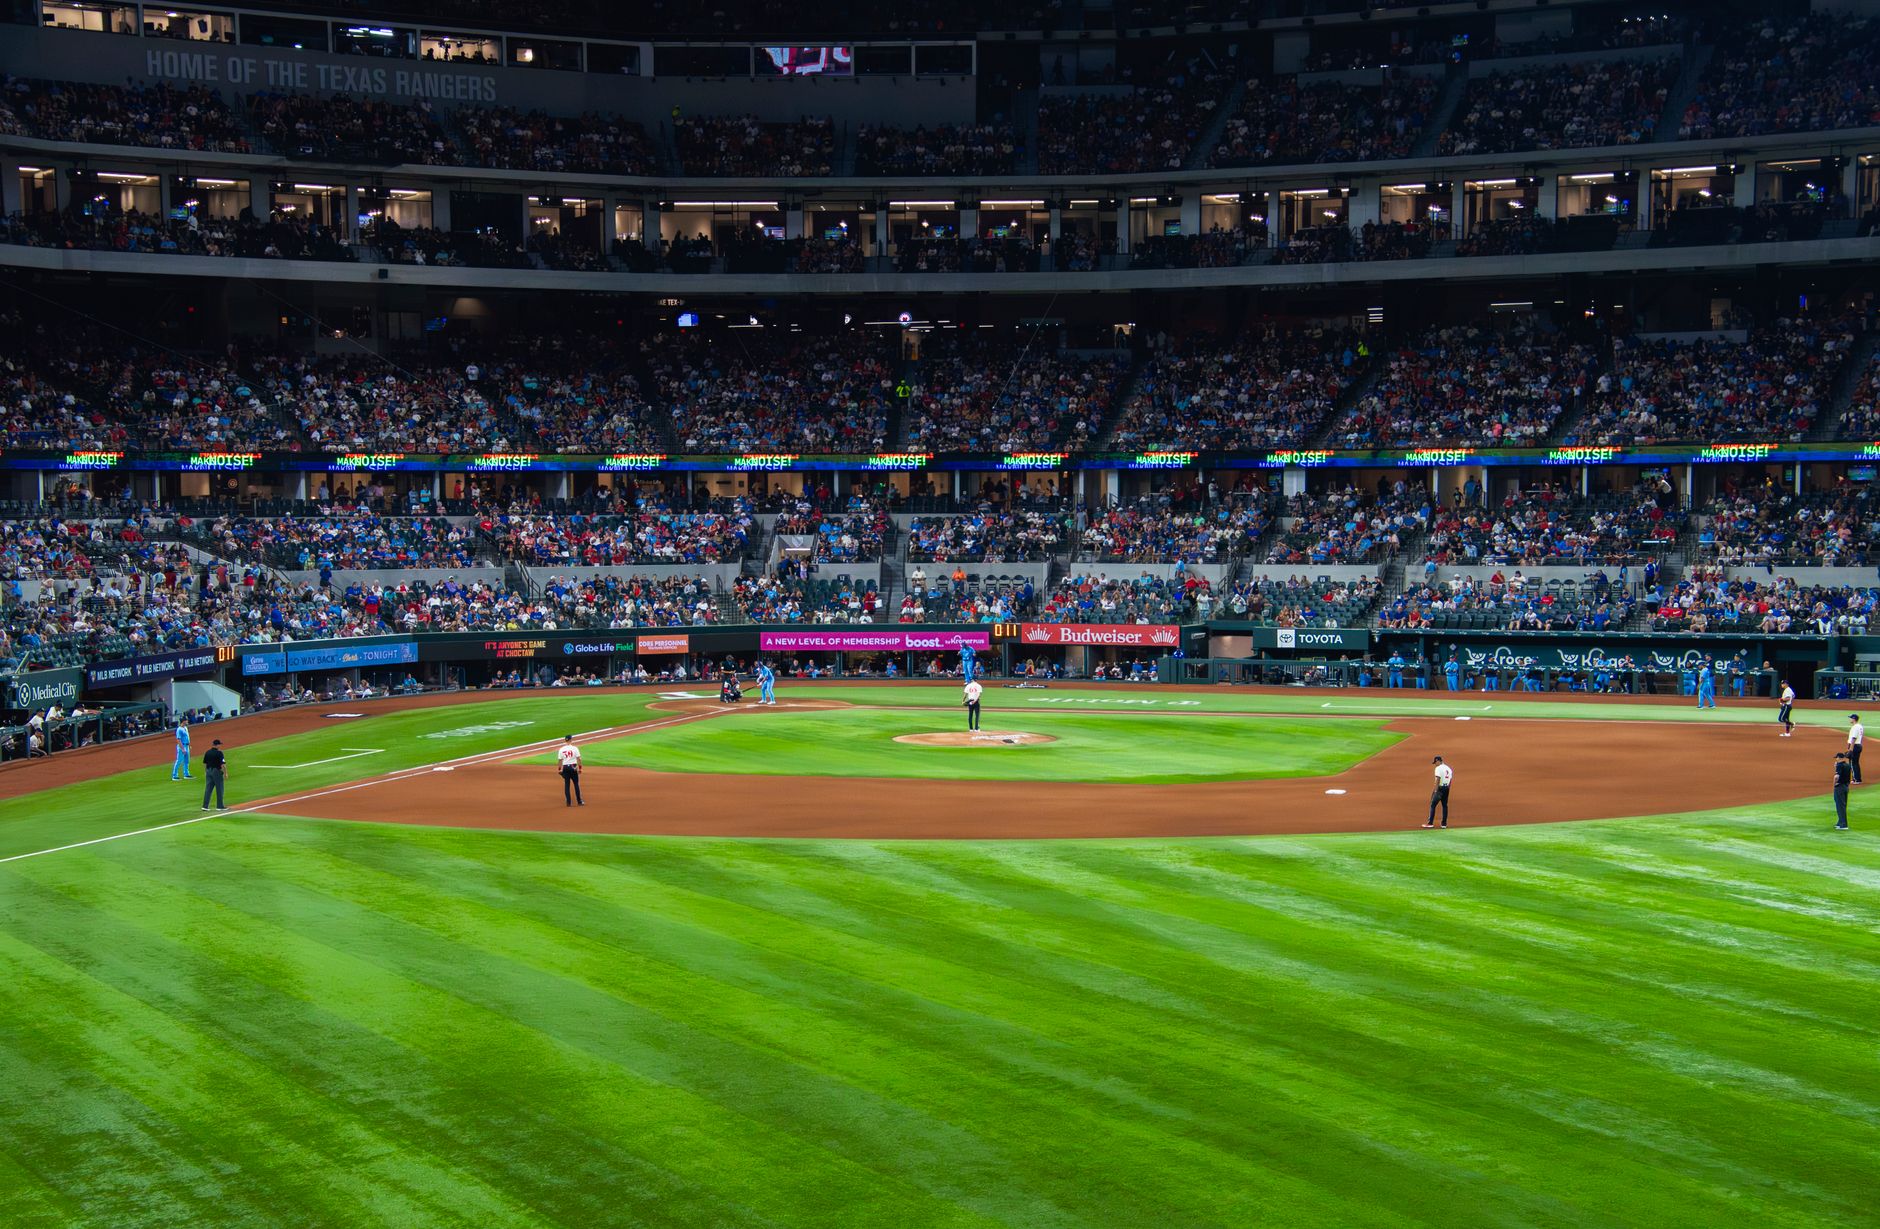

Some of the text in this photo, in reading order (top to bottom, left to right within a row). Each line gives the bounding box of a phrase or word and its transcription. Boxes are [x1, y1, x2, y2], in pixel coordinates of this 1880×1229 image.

[146, 49, 497, 102] HOME OF THE TEXAS RANGERS
[1060, 627, 1142, 643] Budweiser
[1299, 634, 1343, 644] TOYOTA
[485, 640, 546, 650] IT'S ANYONE'S GAME
[575, 643, 634, 653] Globe Life Field
[289, 656, 300, 667] GO
[302, 655, 316, 666] WAY
[364, 649, 398, 661] TONIGHT
[505, 649, 535, 657] CHOCTAW
[142, 661, 175, 674] MLB NETWORK
[184, 655, 215, 668] MLB NETWORK
[97, 666, 132, 681] MLB NETWORK
[32, 682, 77, 701] Medical City
